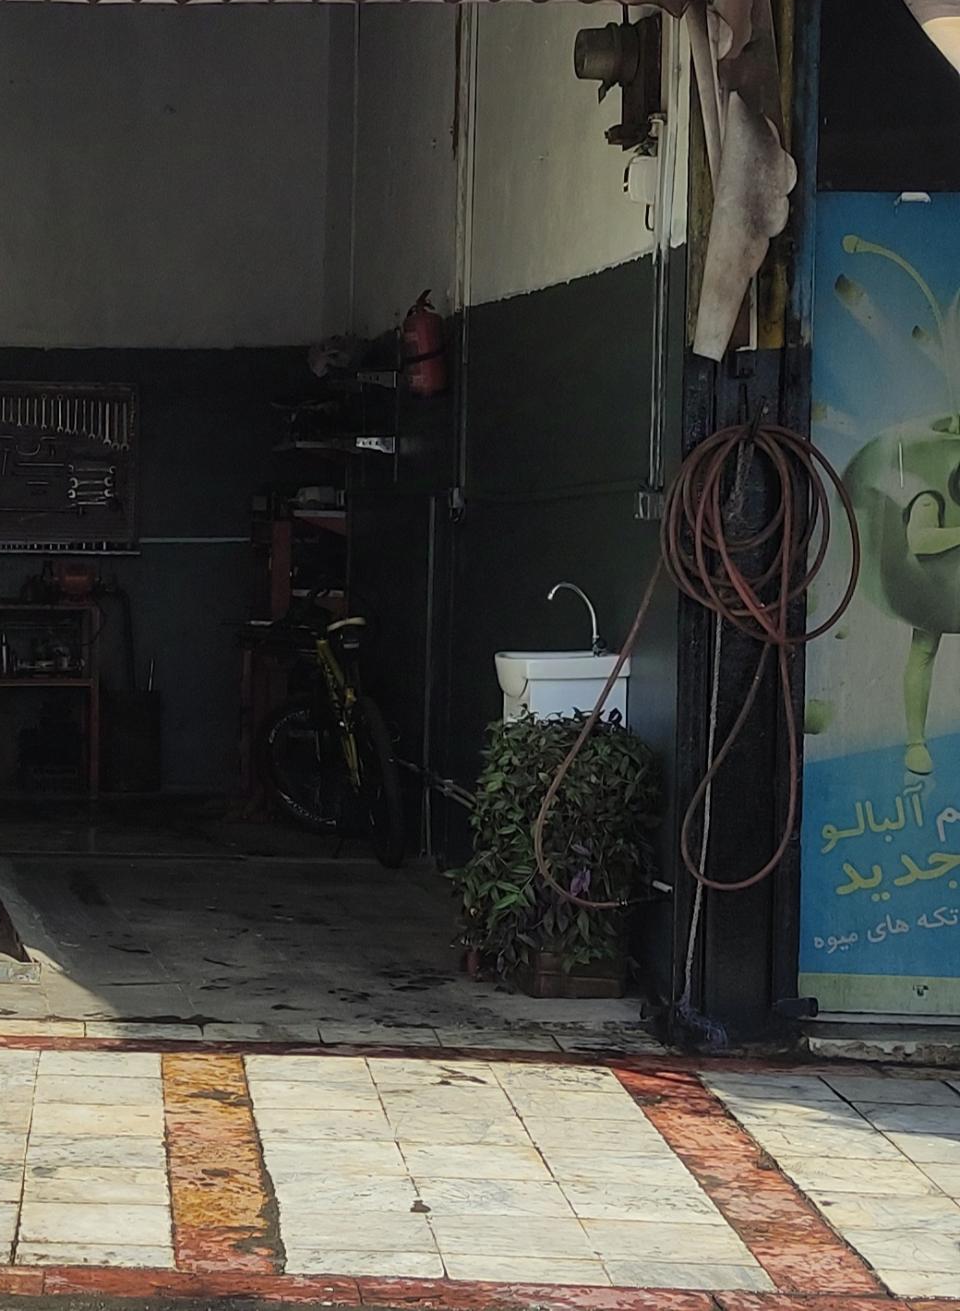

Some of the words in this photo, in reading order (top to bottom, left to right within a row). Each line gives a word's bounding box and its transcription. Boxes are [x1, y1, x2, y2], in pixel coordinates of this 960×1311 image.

[821, 783, 923, 854] آلبالو
[836, 852, 960, 902] جدید
[867, 914, 910, 943] های
[917, 906, 959, 928] تکه
[814, 932, 859, 955] میوه
